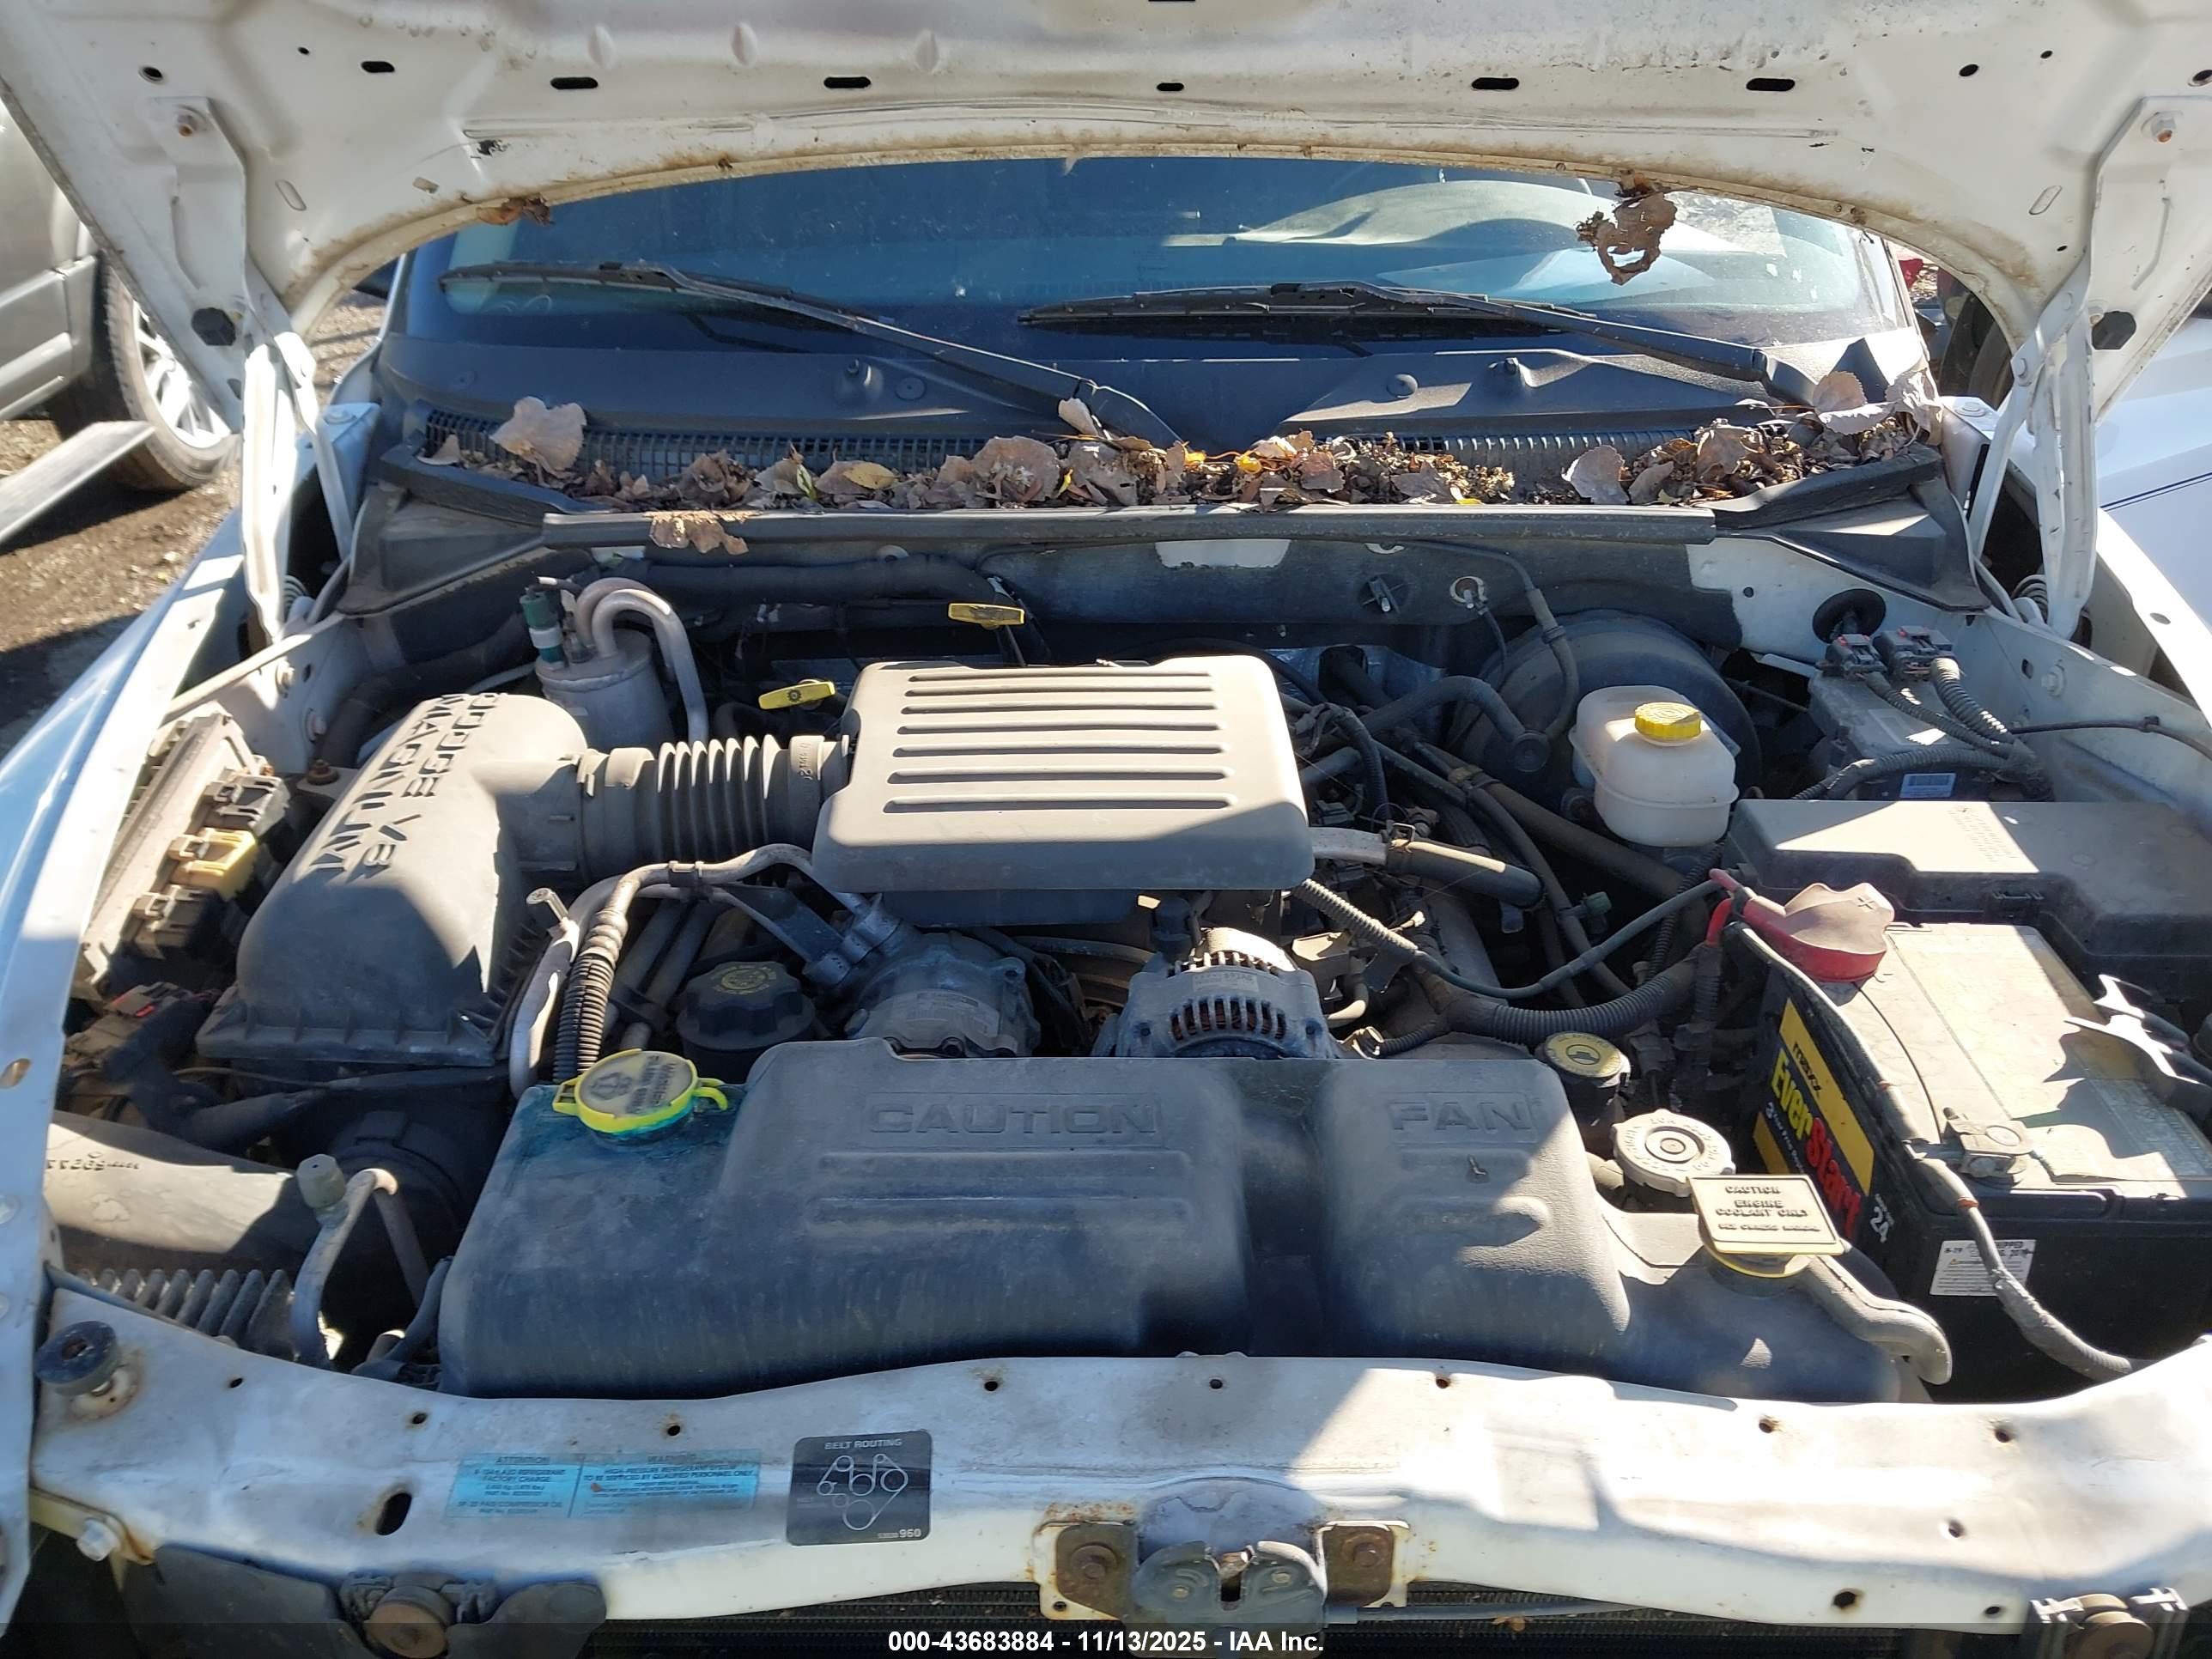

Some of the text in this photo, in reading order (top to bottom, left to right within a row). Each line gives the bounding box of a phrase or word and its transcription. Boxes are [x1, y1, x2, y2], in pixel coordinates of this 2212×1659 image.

[401, 693, 501, 798] DODGE
[867, 1103, 1158, 1134] CAUTION
[1389, 1102, 1531, 1131] FAN
[1724, 1185, 1782, 1194] CAUTION
[1734, 1200, 1784, 1208] ENGINE
[1716, 1208, 1771, 1217] COOLANT
[824, 1438, 902, 1450] BELT ROUTING
[899, 1528, 921, 1538] 960
